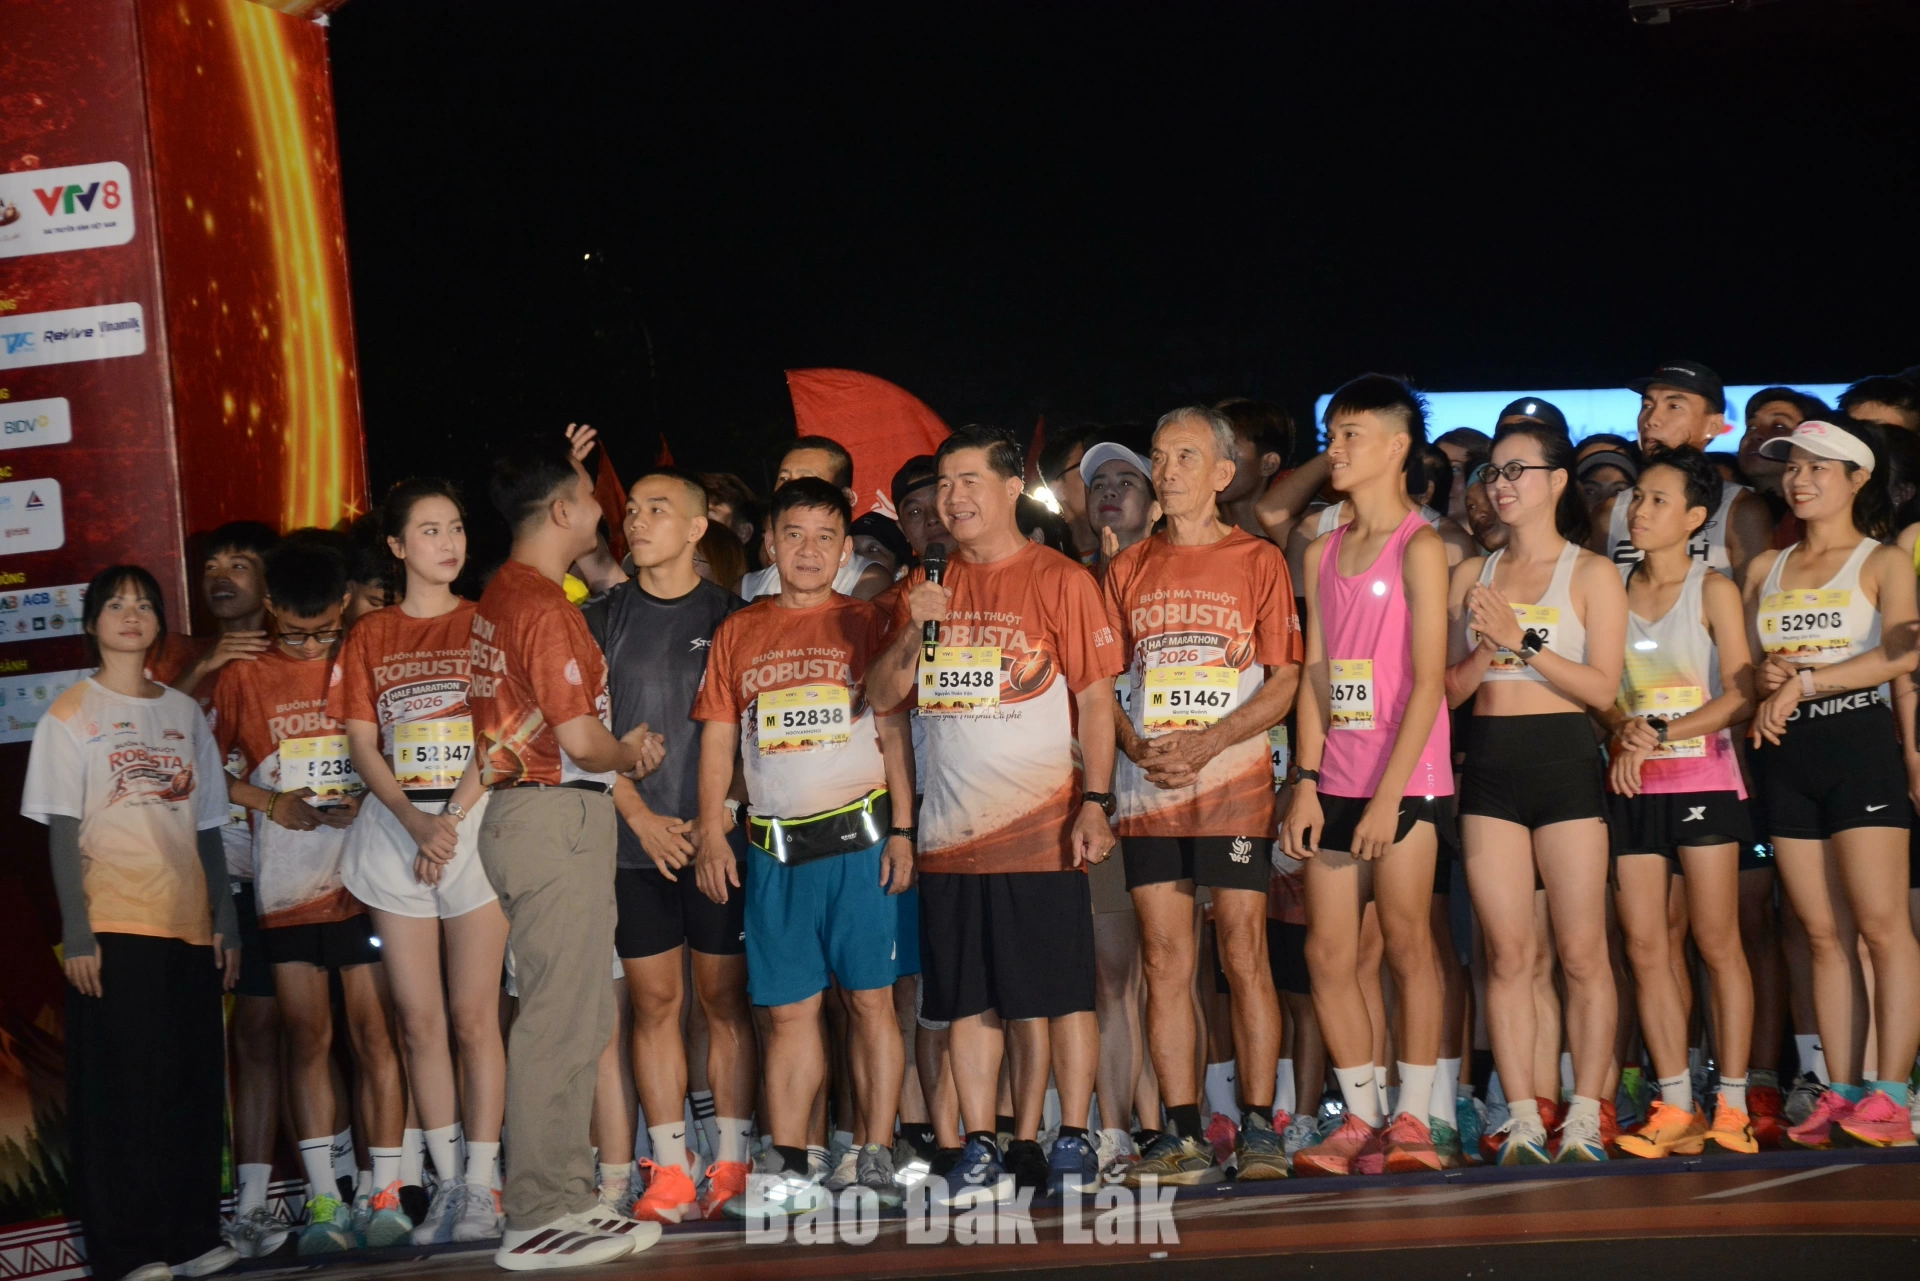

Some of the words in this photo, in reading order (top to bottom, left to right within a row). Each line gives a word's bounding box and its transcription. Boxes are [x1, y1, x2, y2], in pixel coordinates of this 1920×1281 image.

[5, 419, 37, 434] BIDV
[23, 592, 50, 606] ACB
[1140, 588, 1170, 604] BUÔN
[1173, 589, 1192, 599] MA
[1194, 590, 1238, 606] THUỘT
[965, 612, 981, 621] MA
[983, 612, 1023, 626] THUỘT
[1132, 603, 1247, 637] ROBUSTA
[1781, 611, 1842, 632] 52908
[939, 625, 1031, 653] OBUSTA
[1168, 635, 1219, 646] MARATHON
[382, 650, 414, 664] BUÔN
[416, 650, 433, 659] MA
[435, 649, 471, 660] THUỘT
[752, 650, 784, 665] BUÔN
[786, 649, 805, 657] MA
[807, 647, 847, 659] THUỘT
[1159, 649, 1199, 665] 2026
[741, 659, 852, 699] ROBUSTA
[925, 674, 934, 686] M
[939, 671, 994, 688] 53438
[390, 690, 412, 702] HALF
[412, 682, 460, 696] MARATHON
[1153, 693, 1163, 705] M
[1170, 690, 1231, 708] 51467
[276, 700, 310, 714] BUÔN
[403, 695, 443, 712] 2026
[1809, 692, 1871, 718] NIKE
[766, 716, 776, 727] M
[783, 708, 844, 728] 52838
[268, 712, 347, 745] ROBU
[108, 749, 183, 772] ROBSTA
[402, 749, 408, 761] F
